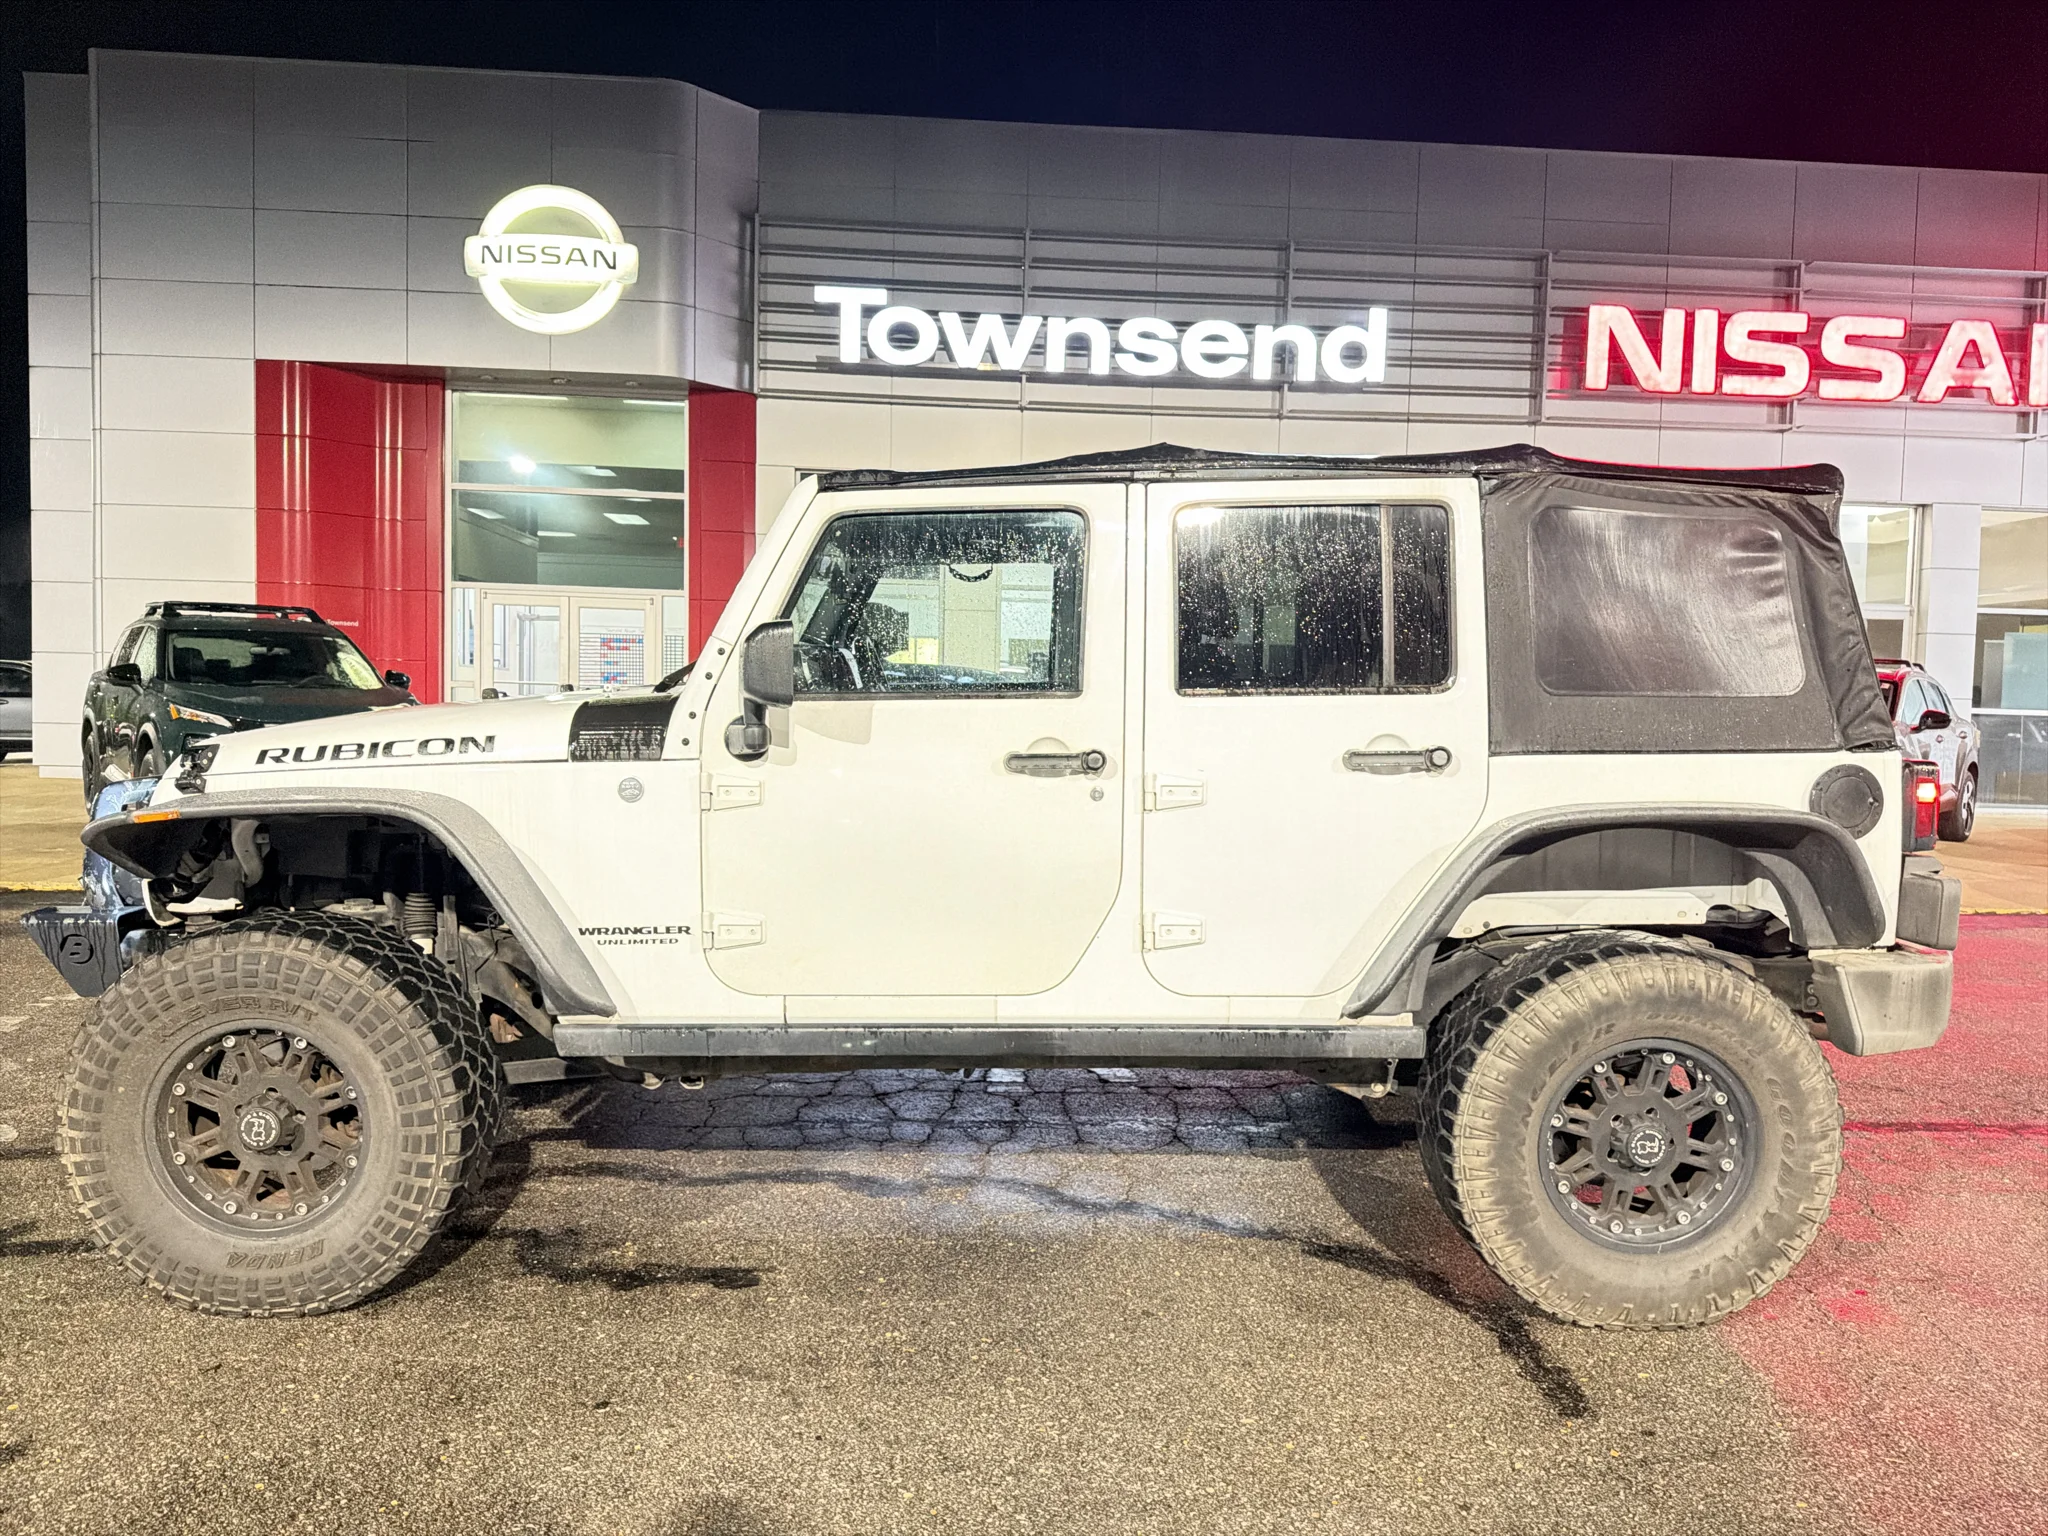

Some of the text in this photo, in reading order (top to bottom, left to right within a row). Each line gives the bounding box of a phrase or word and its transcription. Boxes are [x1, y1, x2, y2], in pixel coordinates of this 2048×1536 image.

[481, 244, 617, 271] NISSAN
[814, 285, 2048, 407] Townsend NISSA
[255, 734, 498, 765] RUBICON
[577, 925, 693, 936] WRANGLER
[596, 938, 679, 946] UNLIMITED
